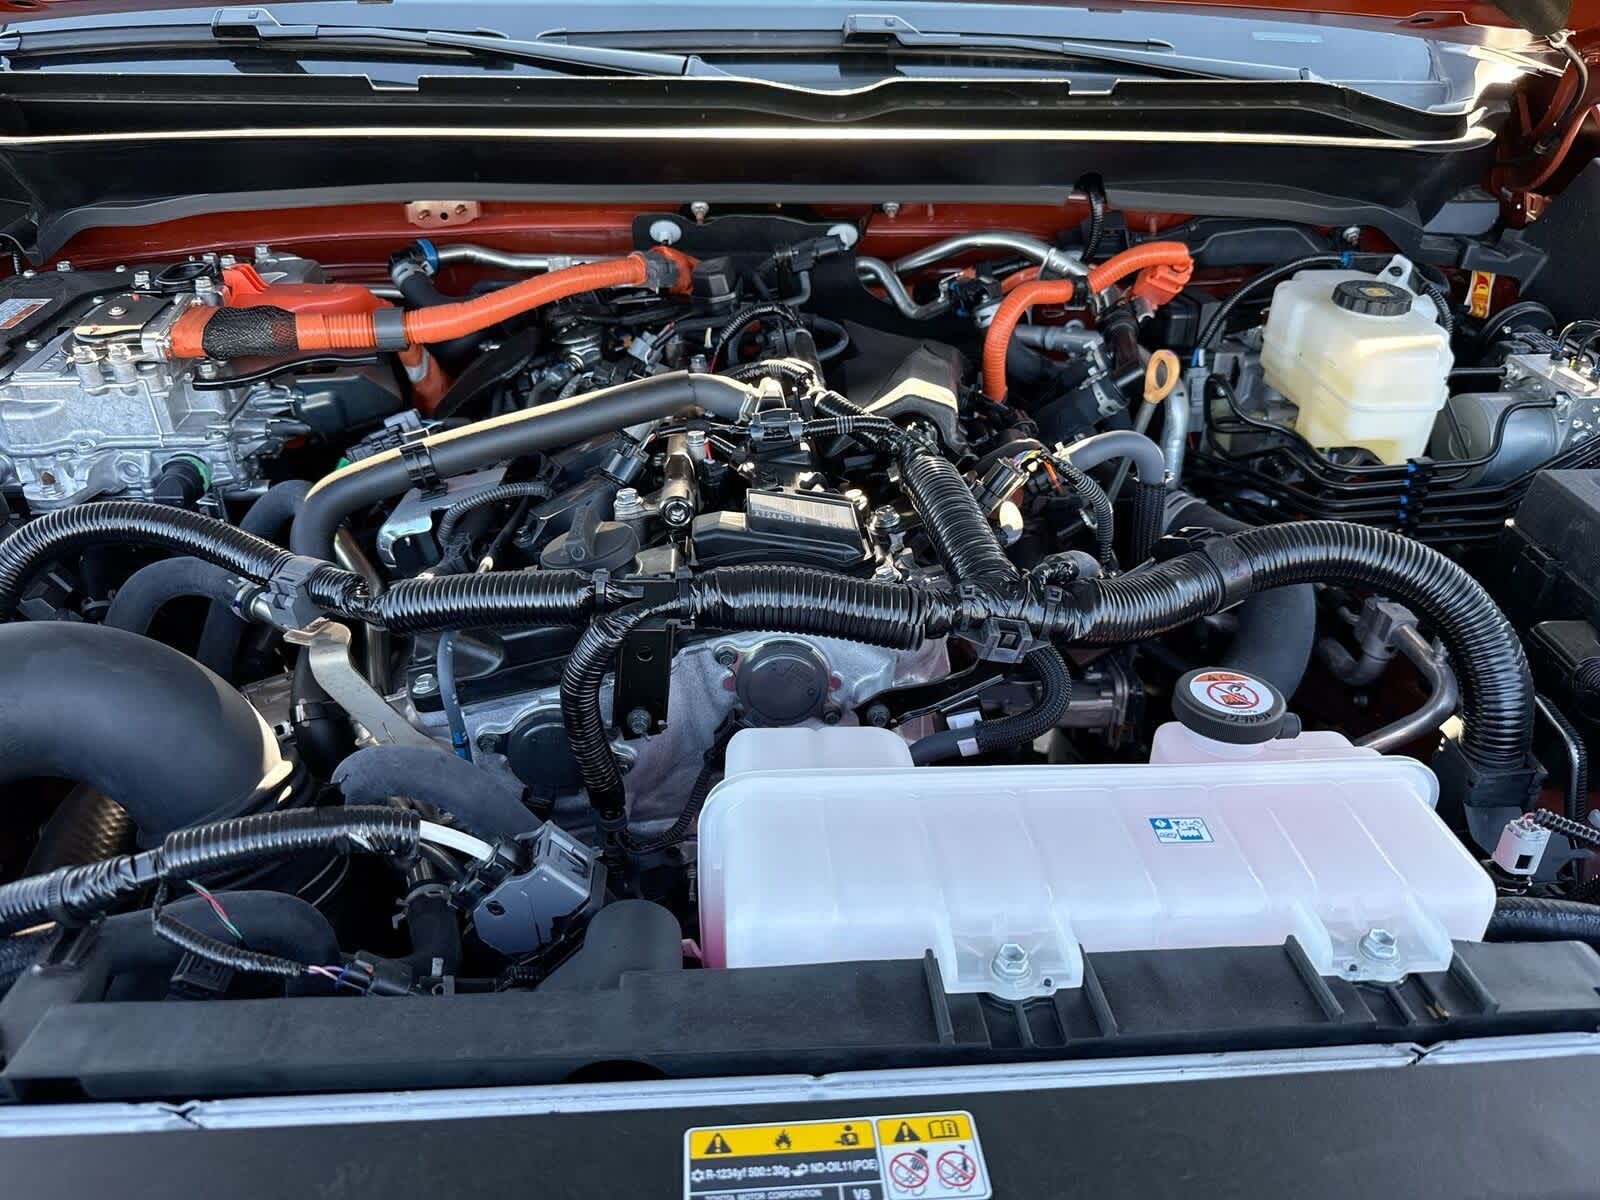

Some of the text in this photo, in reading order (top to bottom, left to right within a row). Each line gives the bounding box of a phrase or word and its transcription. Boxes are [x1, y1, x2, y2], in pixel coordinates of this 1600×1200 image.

[705, 1167, 747, 1181] R-1234yf
[737, 1192, 766, 1200] MOTOR
[767, 1189, 823, 1200] CORPORATION
